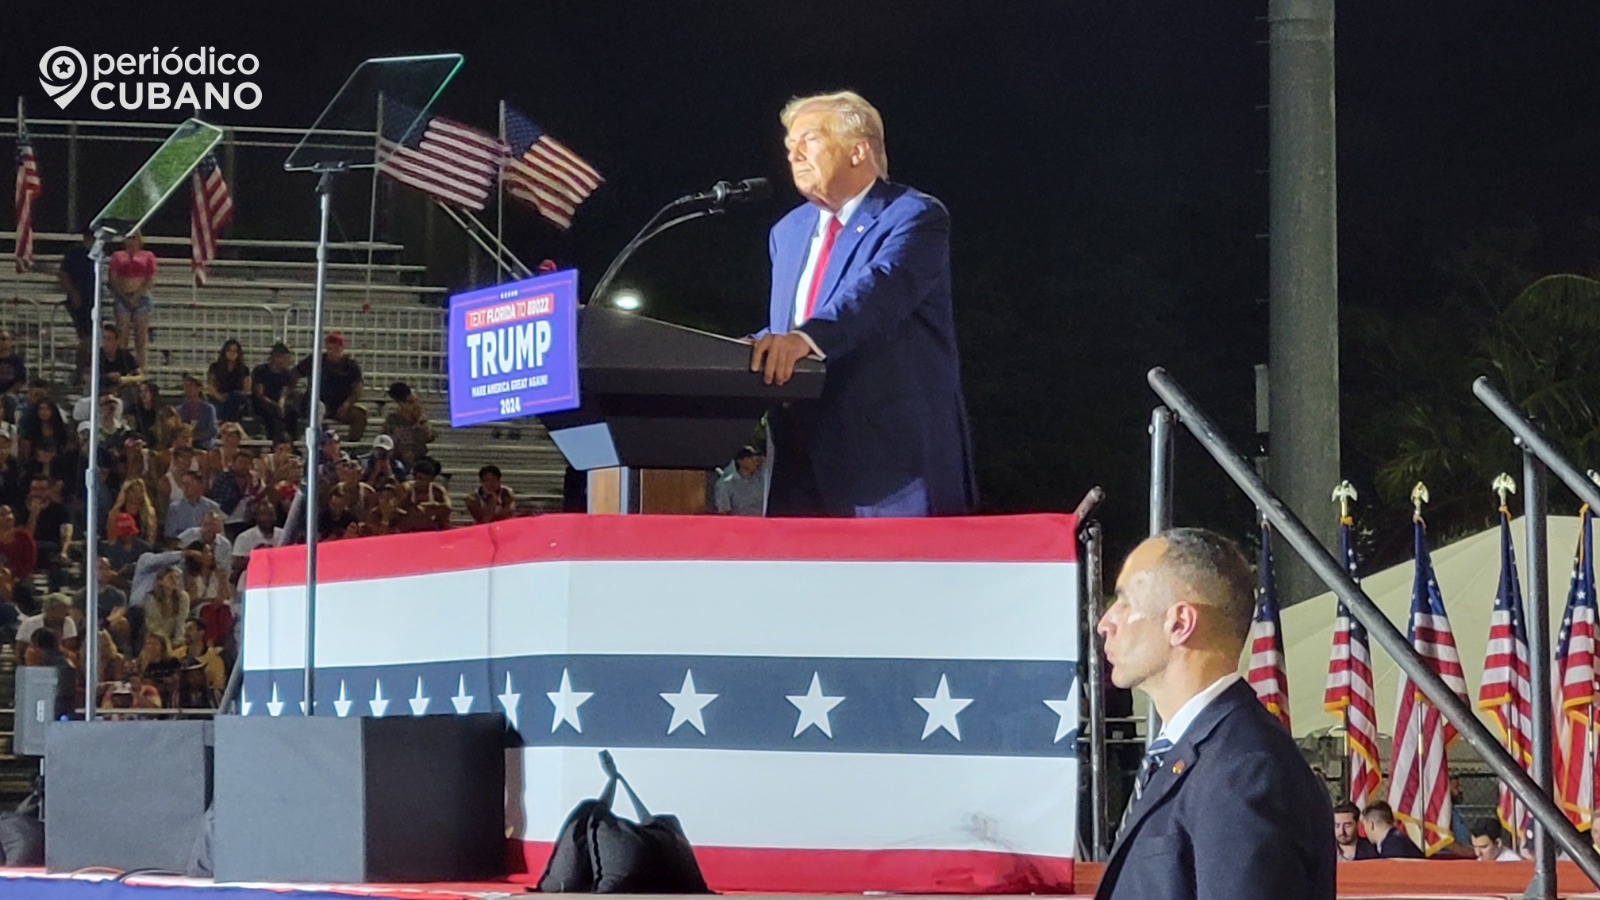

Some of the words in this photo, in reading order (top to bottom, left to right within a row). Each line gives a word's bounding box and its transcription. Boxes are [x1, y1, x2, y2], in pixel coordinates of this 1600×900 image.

[469, 310, 486, 327] TEXT
[486, 304, 516, 324] FLORIDA
[517, 302, 527, 317] TO
[466, 320, 552, 379] TRUMP
[471, 384, 487, 397] MAKE
[487, 381, 510, 395] AMERICA
[511, 378, 527, 391] GREAT
[500, 397, 521, 414] 2024
